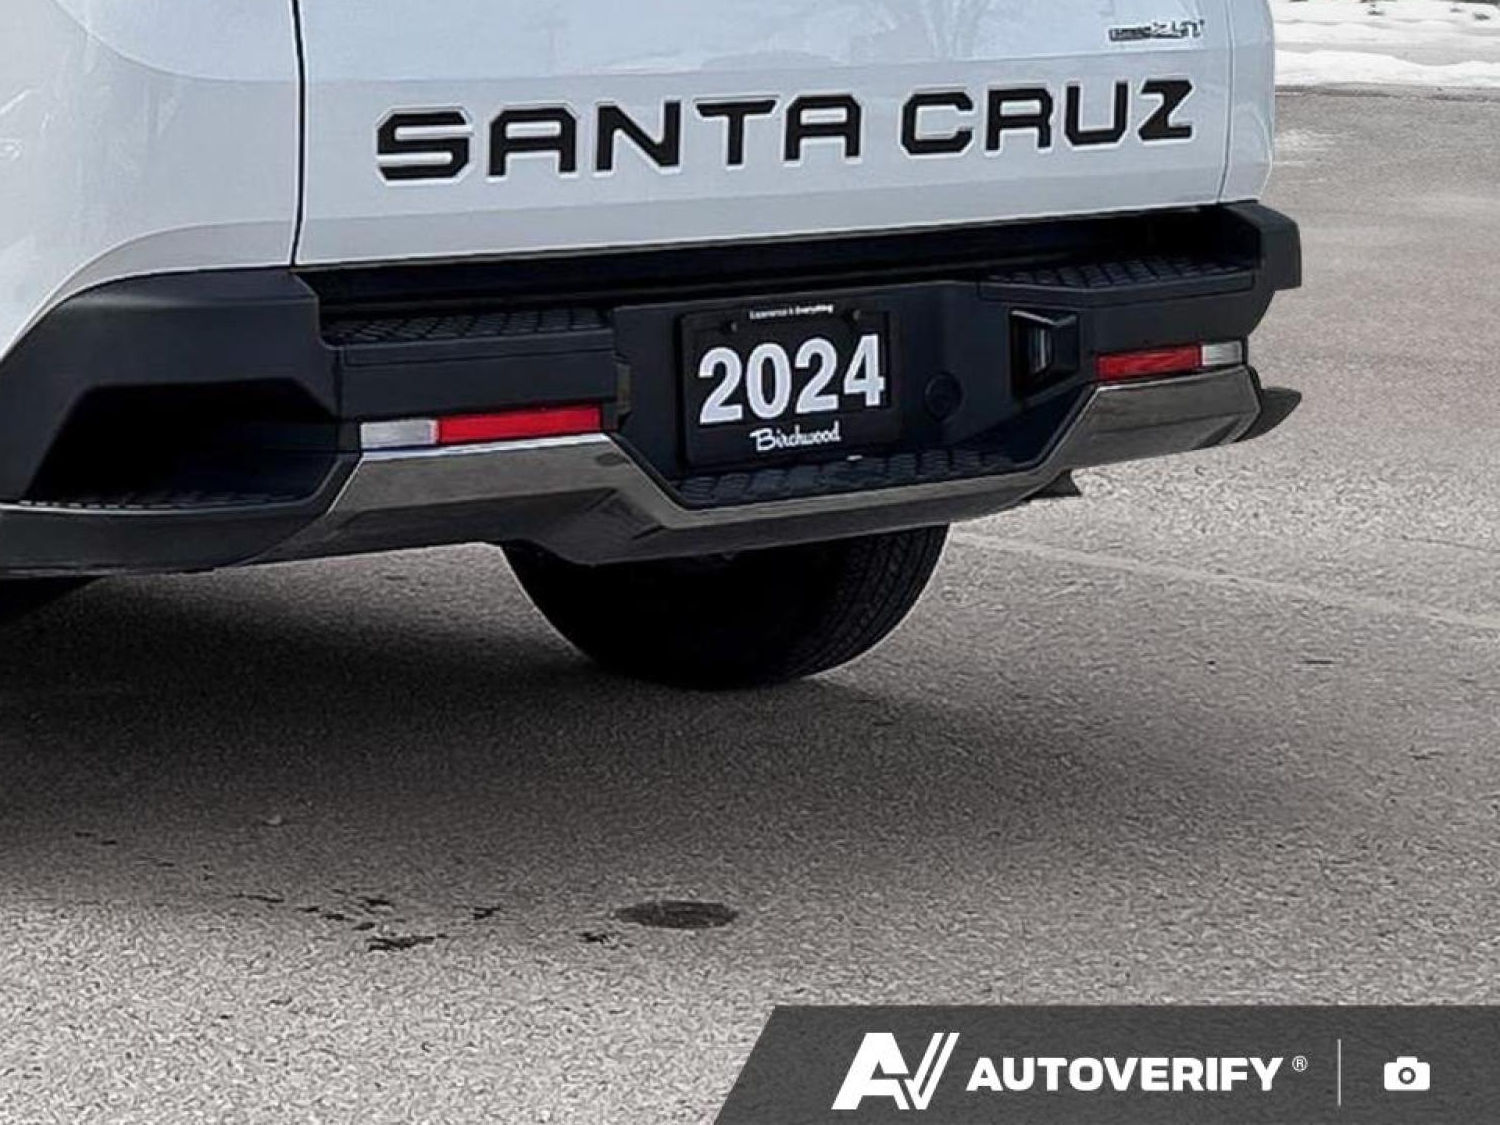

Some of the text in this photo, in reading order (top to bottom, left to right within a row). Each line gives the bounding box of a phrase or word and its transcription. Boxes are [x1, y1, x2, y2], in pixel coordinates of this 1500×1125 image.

[376, 79, 1193, 182] SANTA CRUZ
[698, 333, 885, 424] 2024
[750, 420, 841, 452] Birchwood
